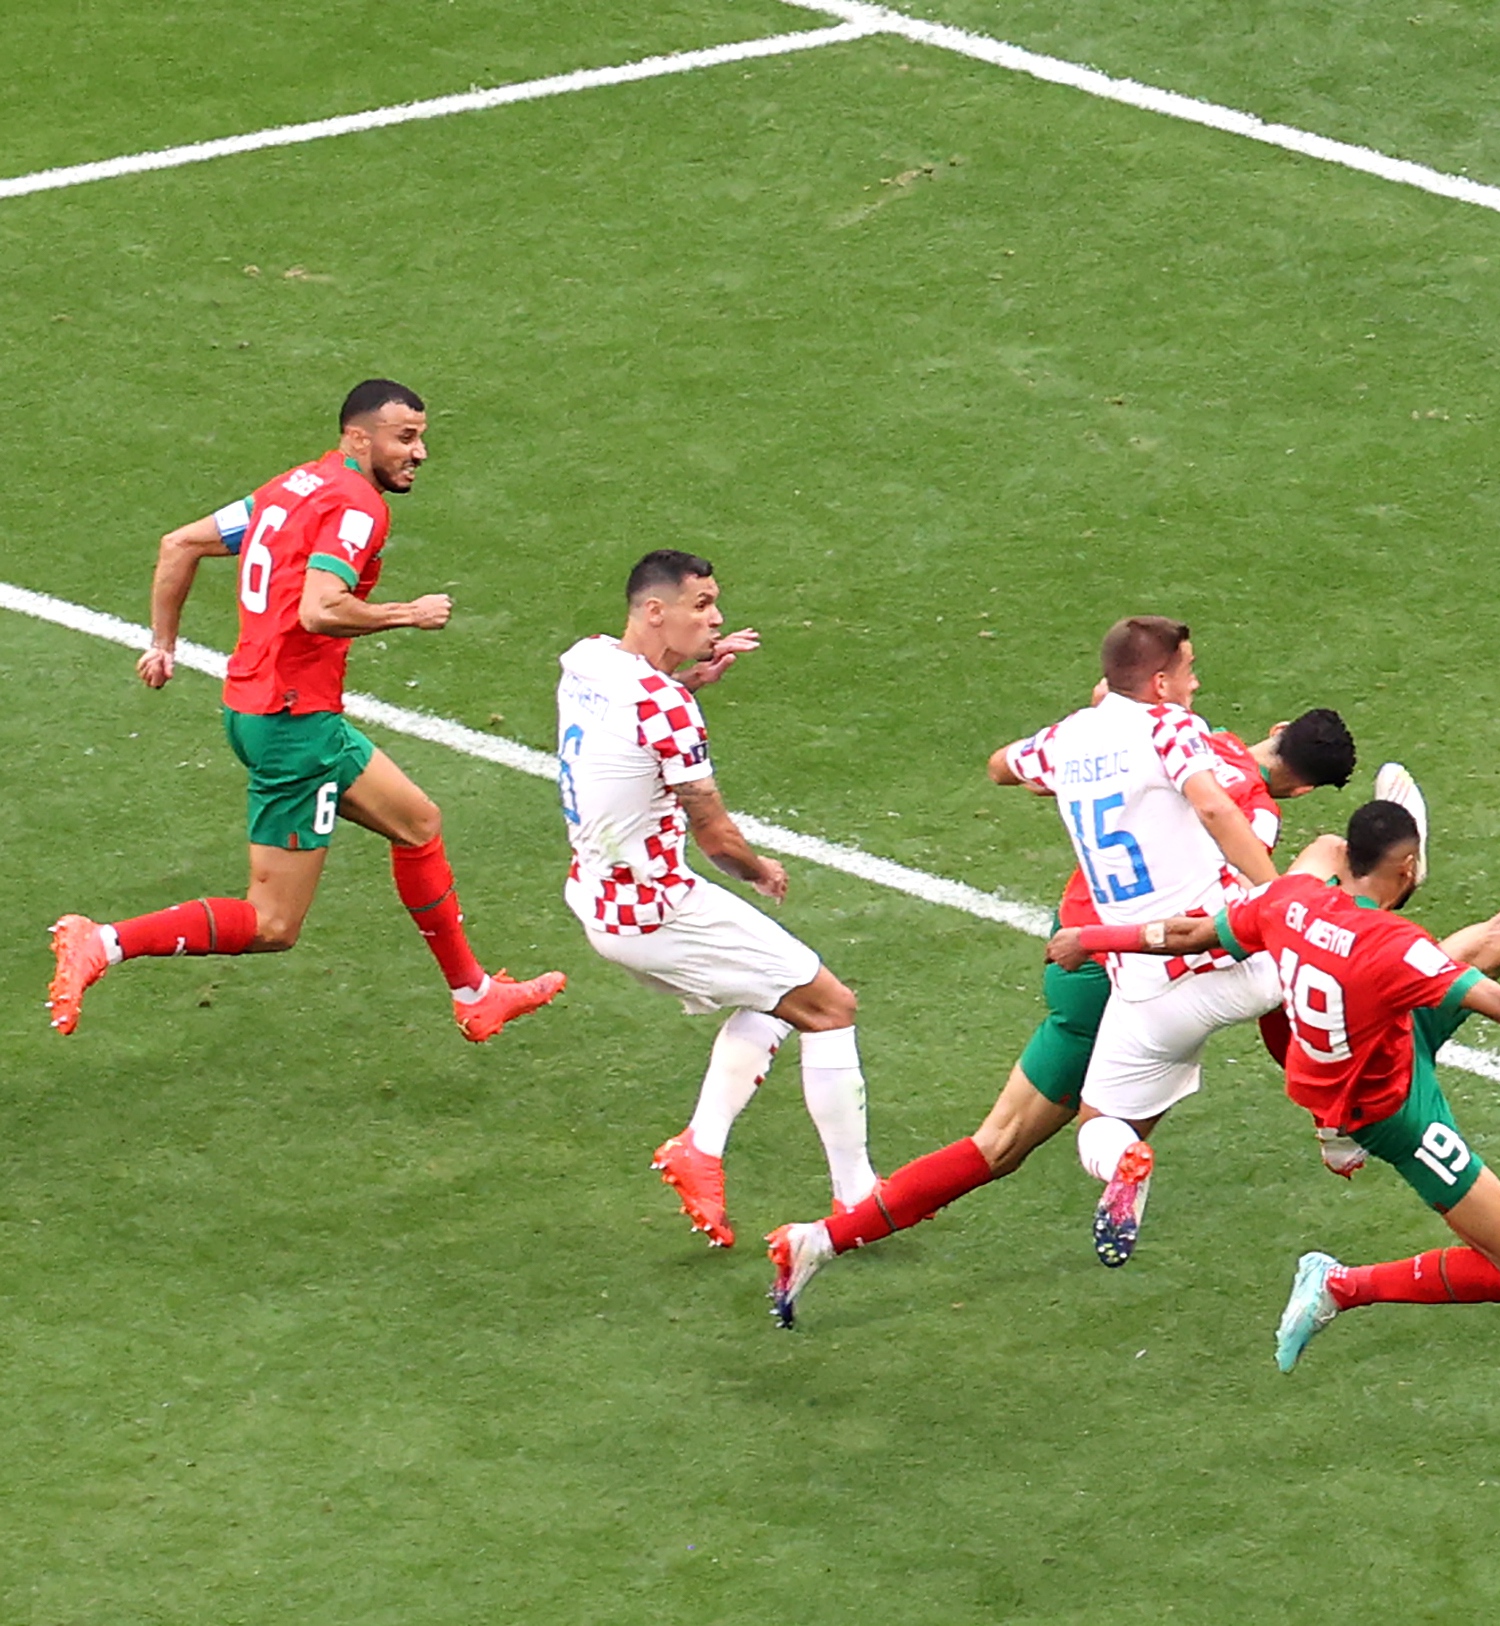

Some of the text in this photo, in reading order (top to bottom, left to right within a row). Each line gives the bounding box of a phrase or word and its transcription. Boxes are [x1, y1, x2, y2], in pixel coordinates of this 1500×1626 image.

[241, 504, 288, 614] 6
[314, 781, 338, 835] 6
[1069, 791, 1155, 904] 15
[1279, 946, 1353, 1064] 19
[1413, 1121, 1471, 1186] 19
